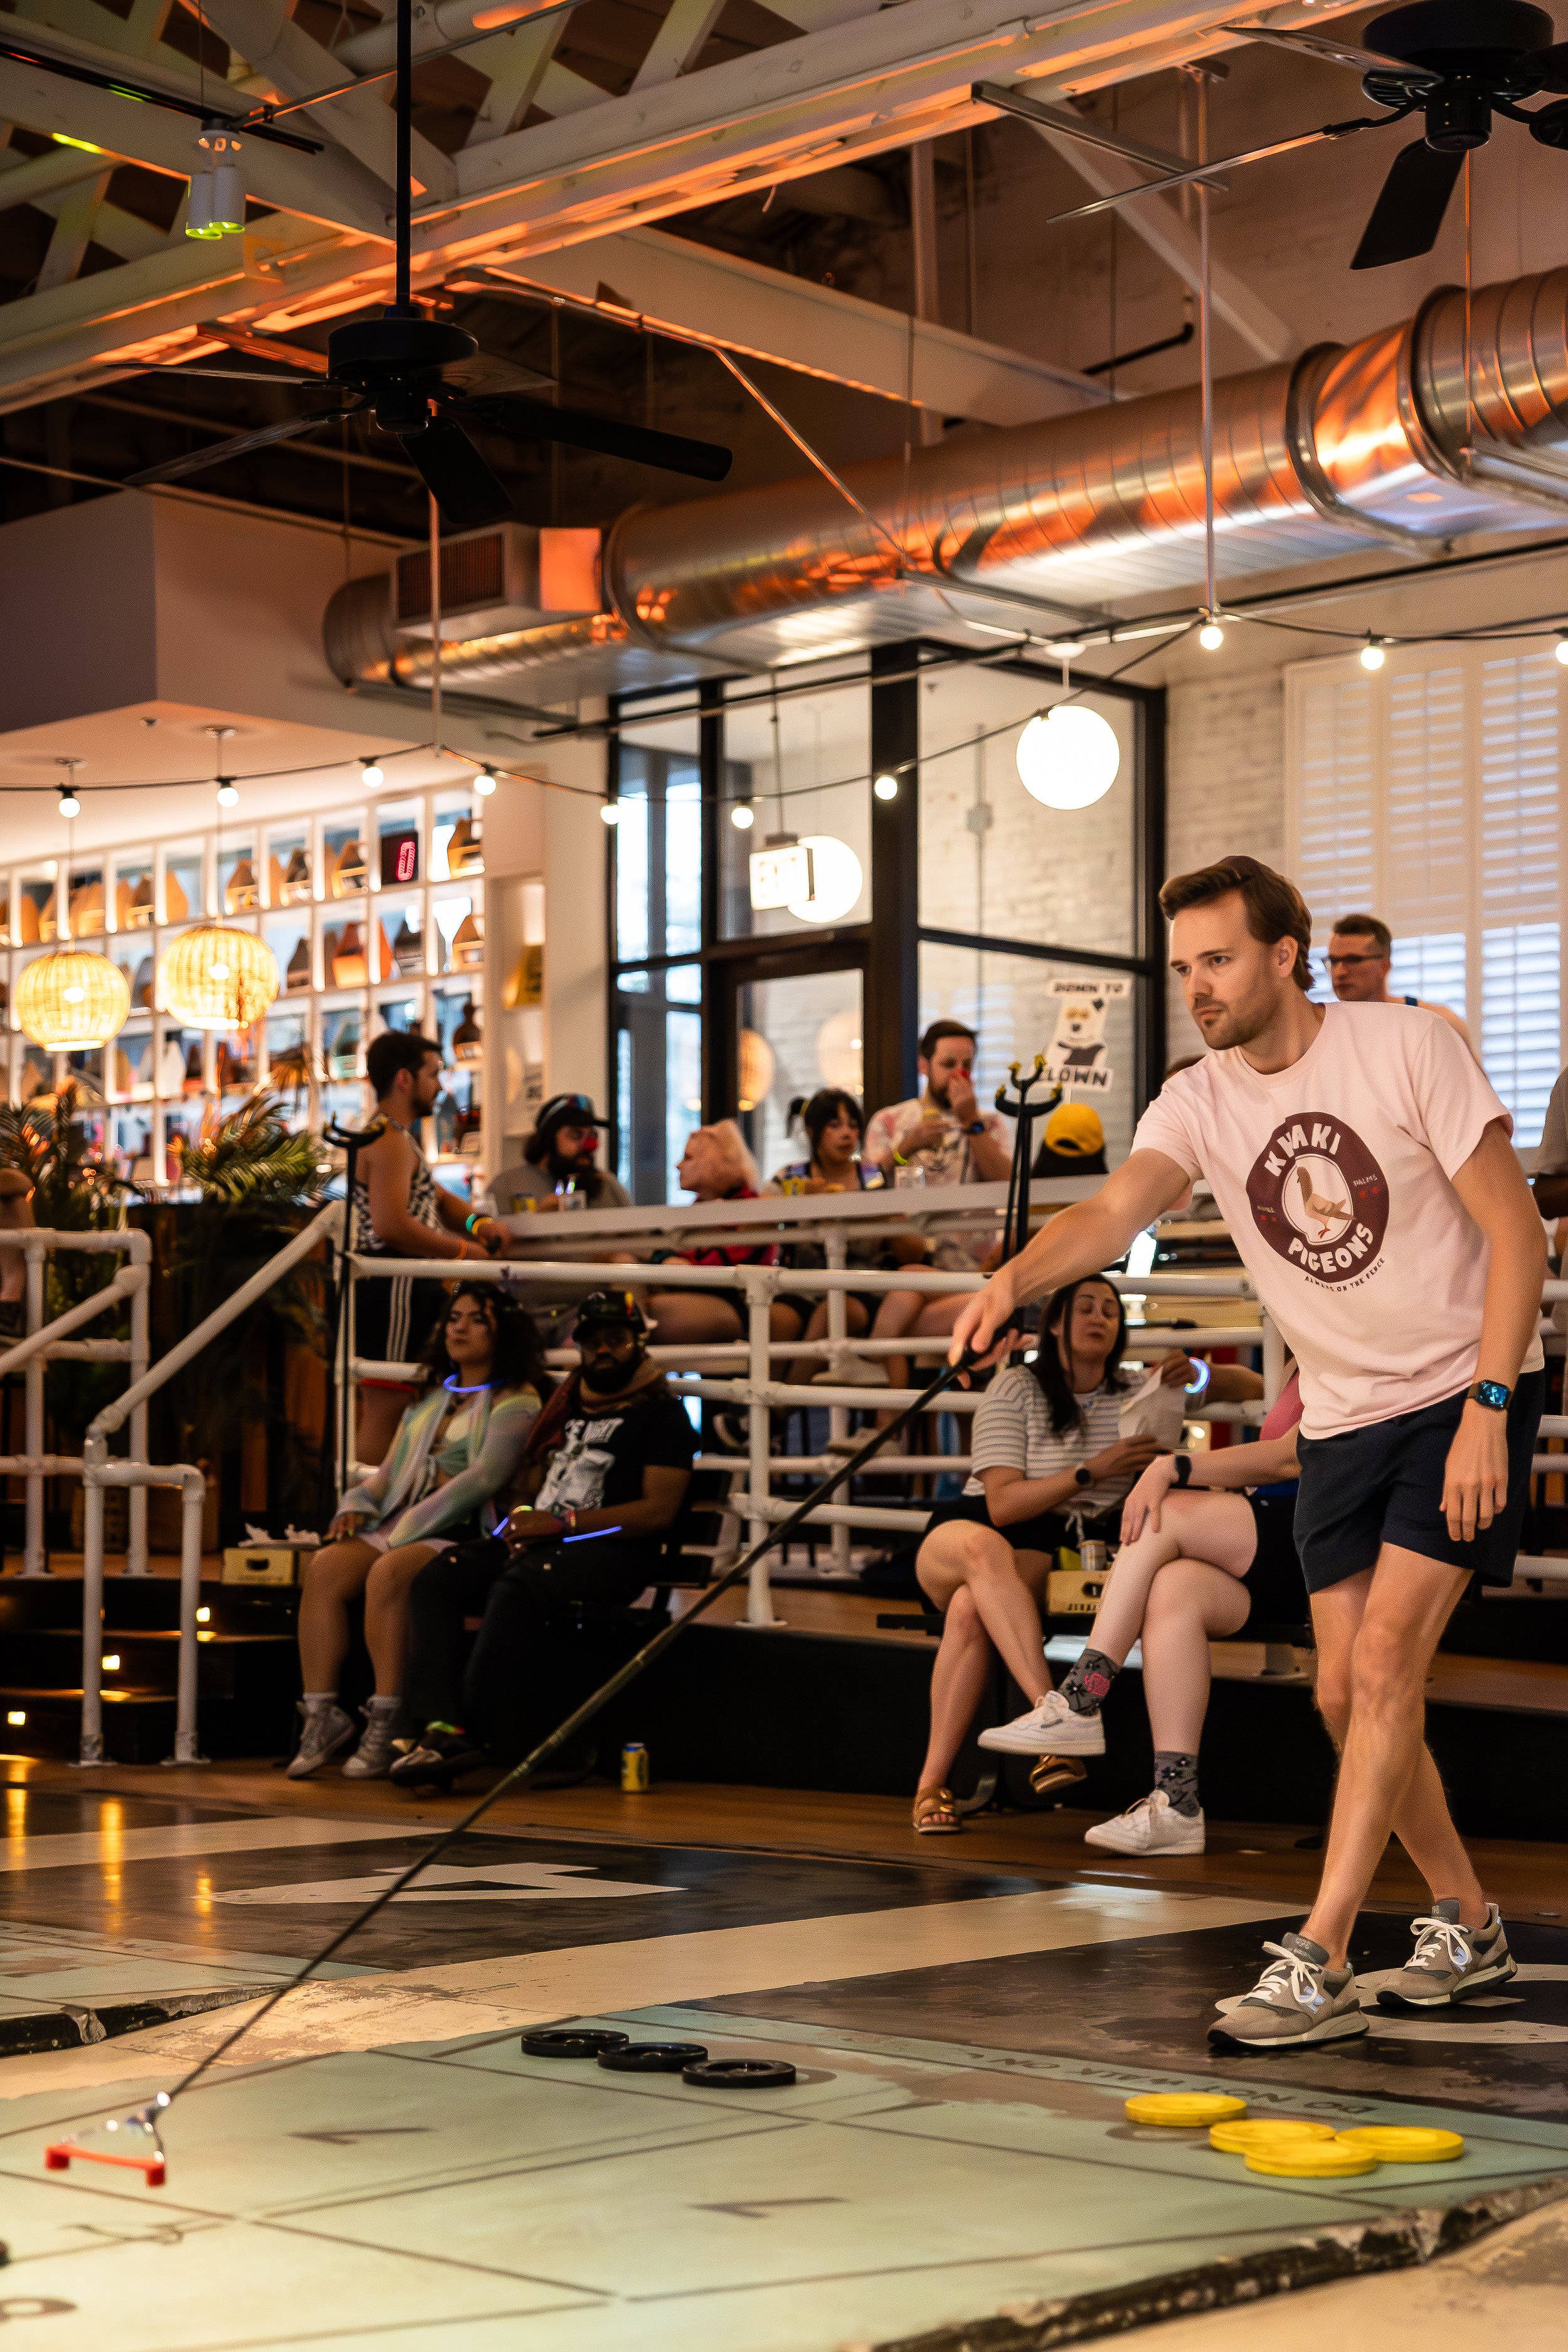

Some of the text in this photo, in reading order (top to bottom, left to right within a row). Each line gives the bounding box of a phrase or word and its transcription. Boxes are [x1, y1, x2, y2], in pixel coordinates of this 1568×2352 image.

[1037, 1067, 1108, 1086] LOWN
[1288, 1222, 1374, 1273] PIGEONS
[1350, 1278, 1365, 1288] THE
